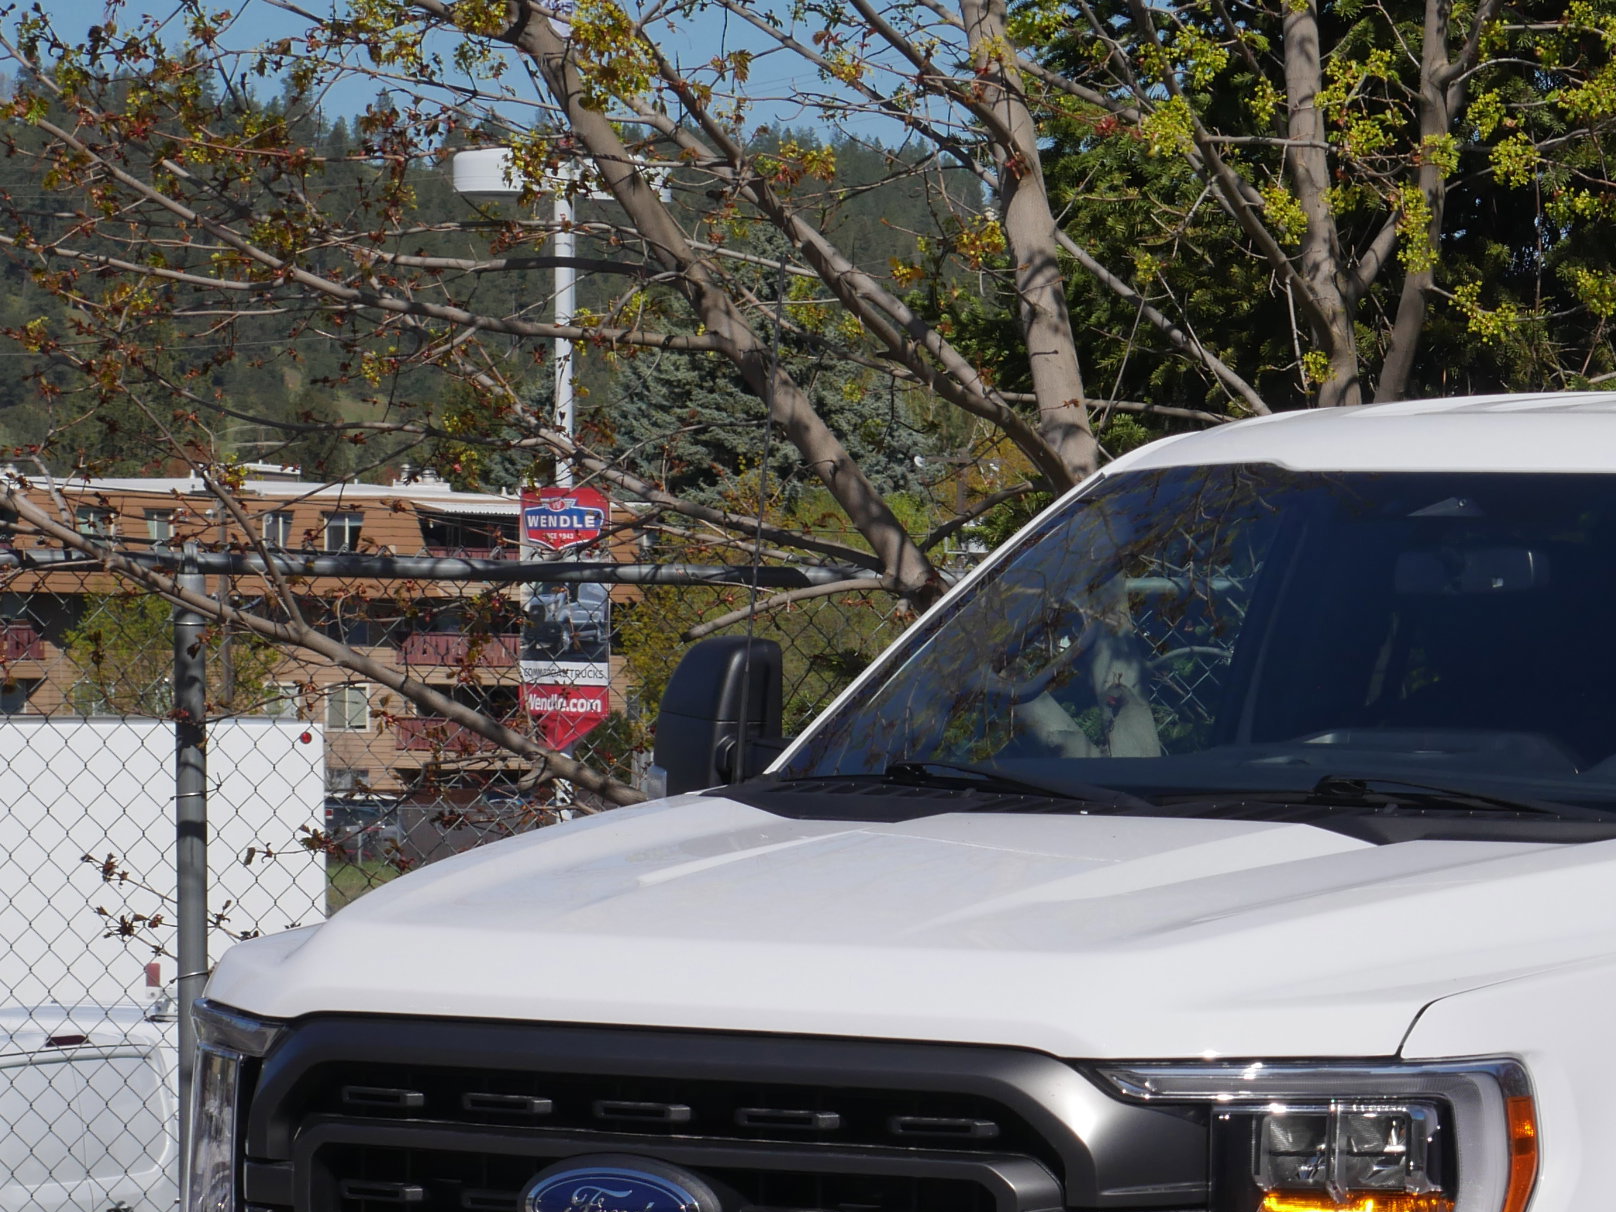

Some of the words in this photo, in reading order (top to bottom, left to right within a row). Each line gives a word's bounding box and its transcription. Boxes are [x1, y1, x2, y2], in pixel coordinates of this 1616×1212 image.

[527, 515, 596, 528] WENDLE
[569, 669, 604, 679] TRUCKS
[528, 693, 602, 713] Wendle.com
